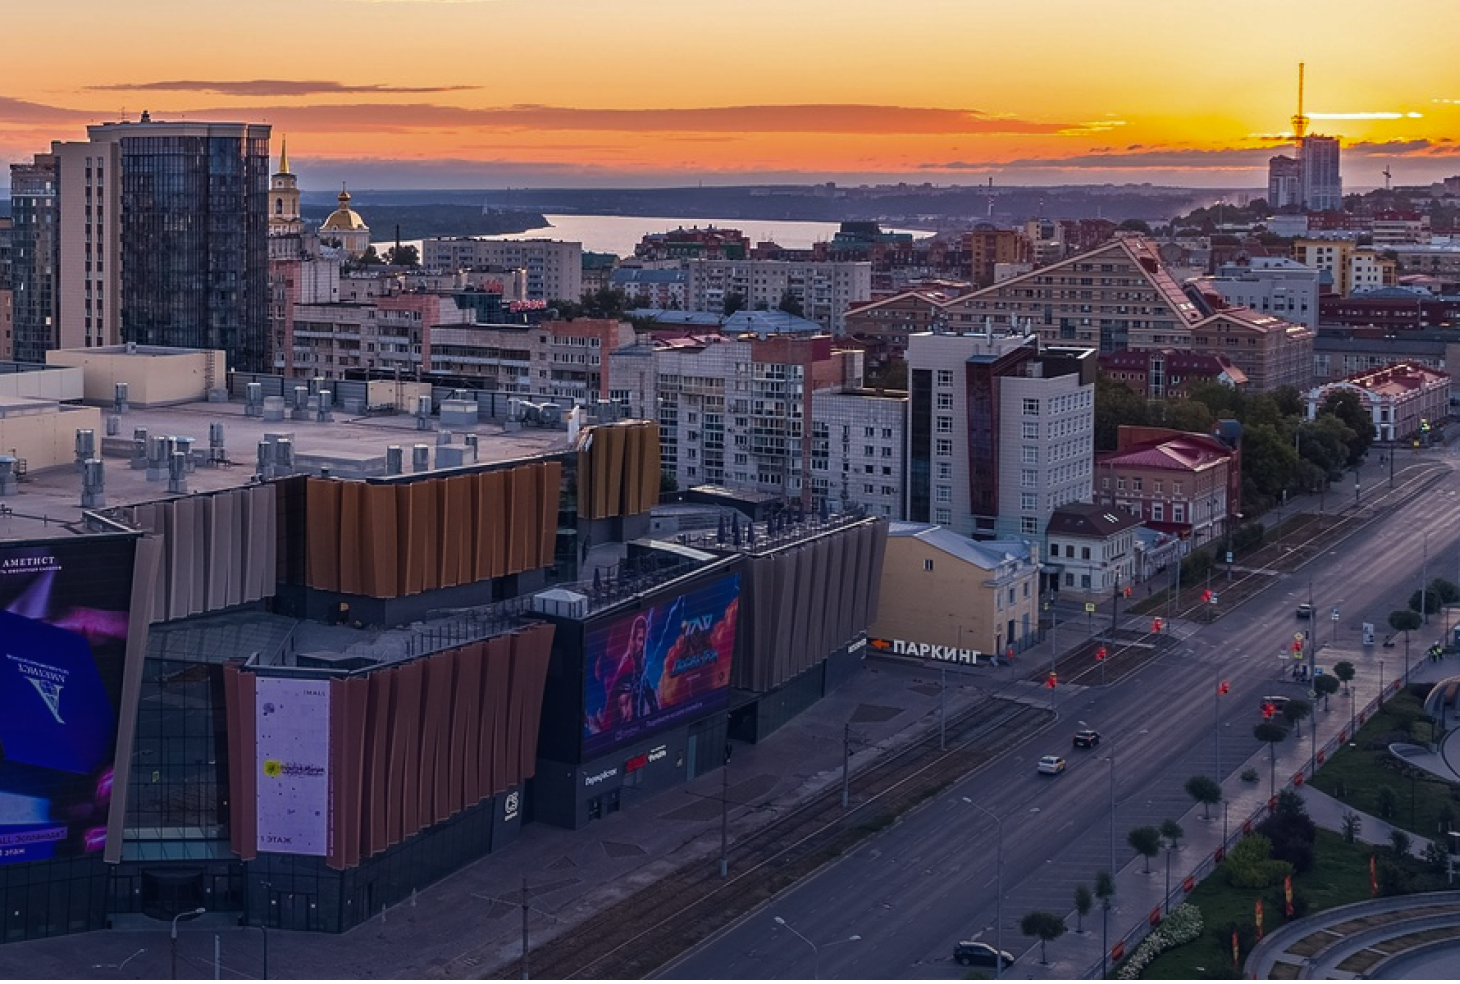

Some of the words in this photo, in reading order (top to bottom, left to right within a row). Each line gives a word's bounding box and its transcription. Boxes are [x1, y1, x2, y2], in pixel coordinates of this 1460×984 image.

[2, 556, 55, 567] АМЕТИСТ
[893, 638, 982, 664] ПАРКИНГ
[267, 836, 293, 845] ЭТАЖ
